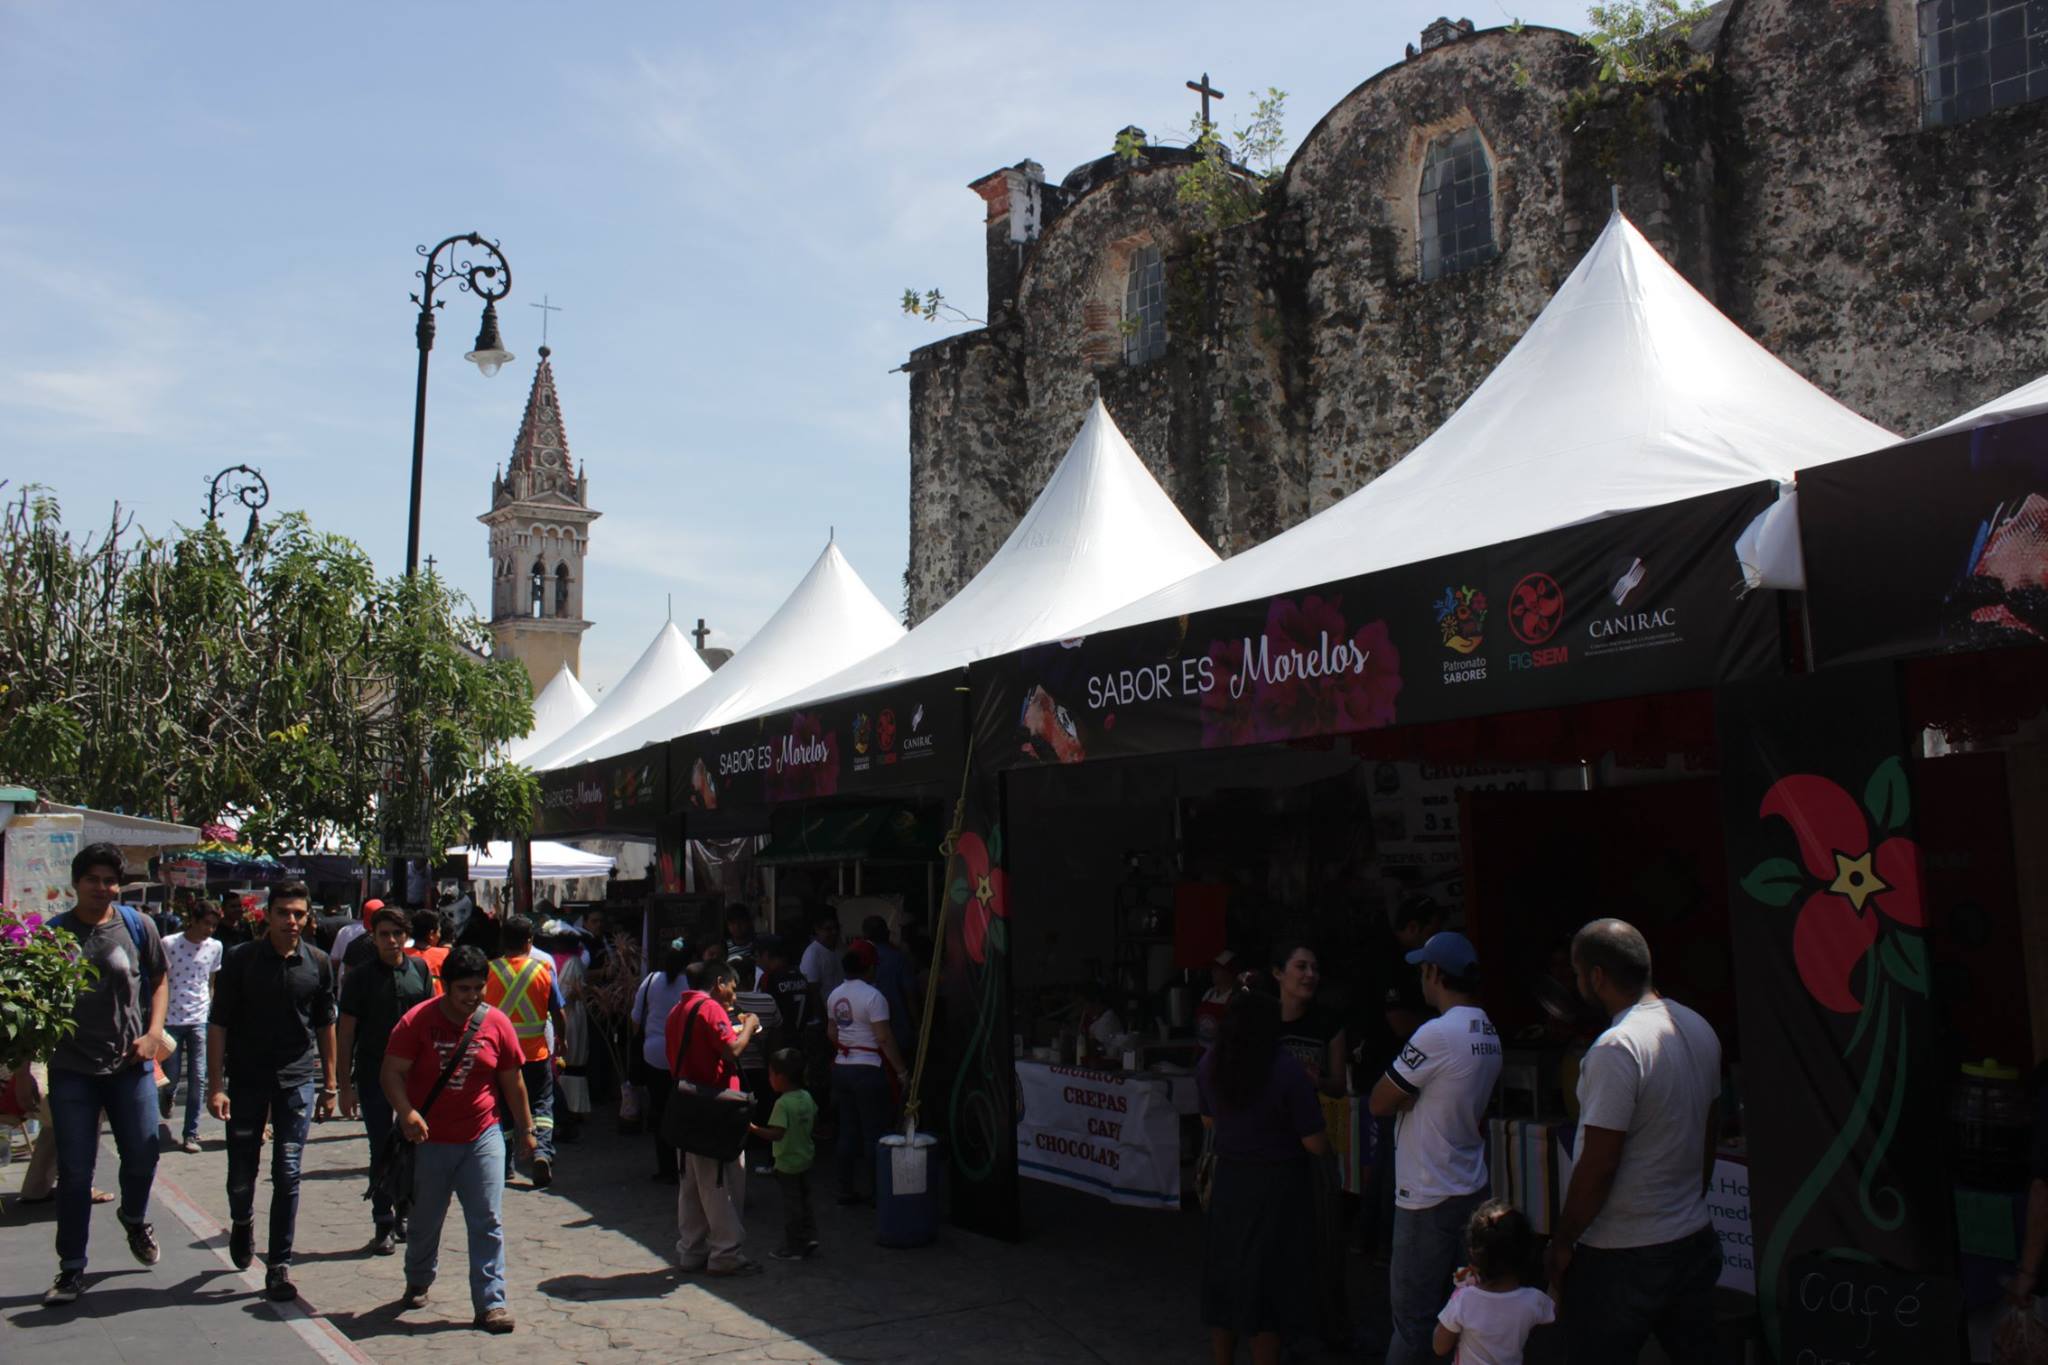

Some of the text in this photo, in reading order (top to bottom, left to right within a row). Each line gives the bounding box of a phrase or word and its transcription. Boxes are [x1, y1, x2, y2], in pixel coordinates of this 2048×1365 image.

[1589, 608, 1675, 638] CANIRAC
[1088, 630, 1369, 709] SABOR ES Morelos
[1443, 657, 1486, 672] Patronato
[1508, 646, 1568, 671] FIGSEM
[1443, 668, 1487, 684] SABORES
[720, 748, 754, 776] SABOR
[758, 746, 771, 769] ES
[777, 735, 829, 774] Morelos
[904, 735, 933, 750] CANIRAC
[1064, 1086, 1127, 1114] CREPAS
[1035, 1133, 1120, 1171] CHOCOLATE
[1800, 1273, 1928, 1350] Café
